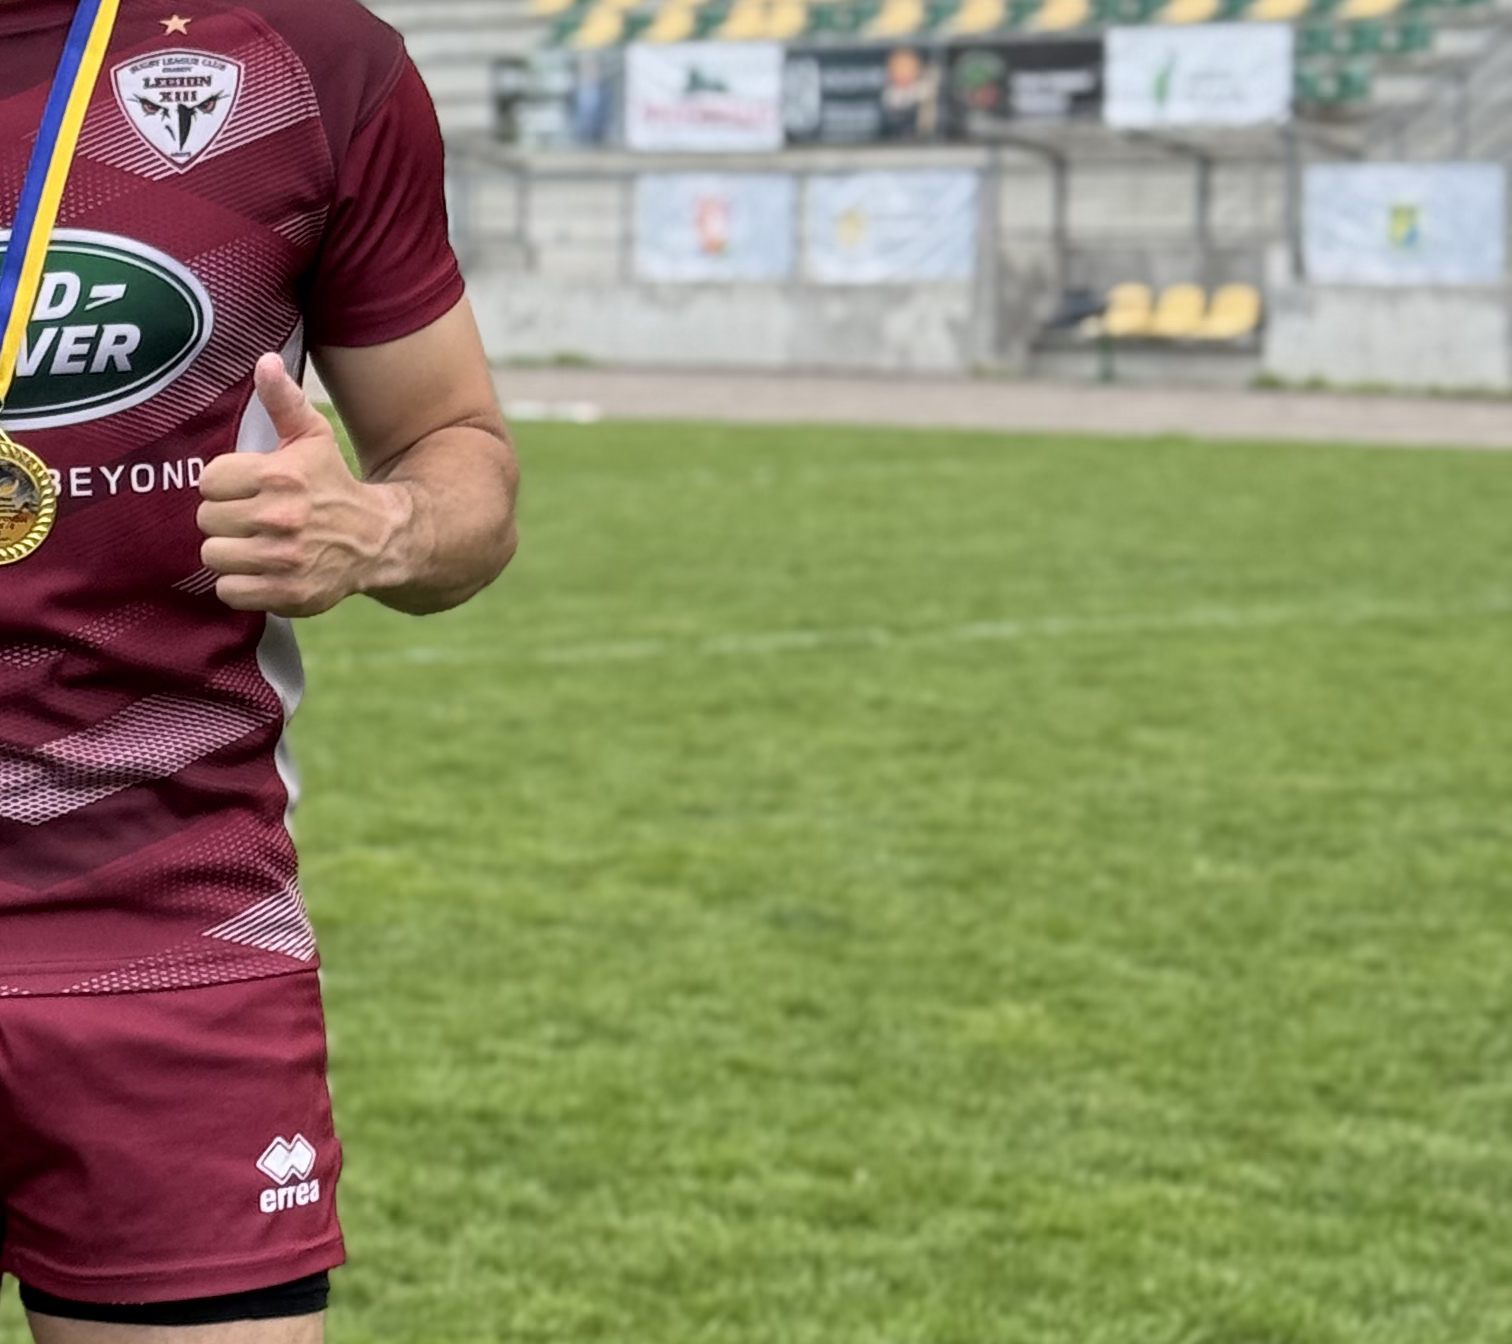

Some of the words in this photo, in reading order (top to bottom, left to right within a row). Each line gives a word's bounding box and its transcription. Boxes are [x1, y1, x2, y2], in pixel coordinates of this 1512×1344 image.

[142, 75, 212, 90] LEGION
[159, 90, 198, 103] XIII
[260, 1178, 321, 1214] errea
